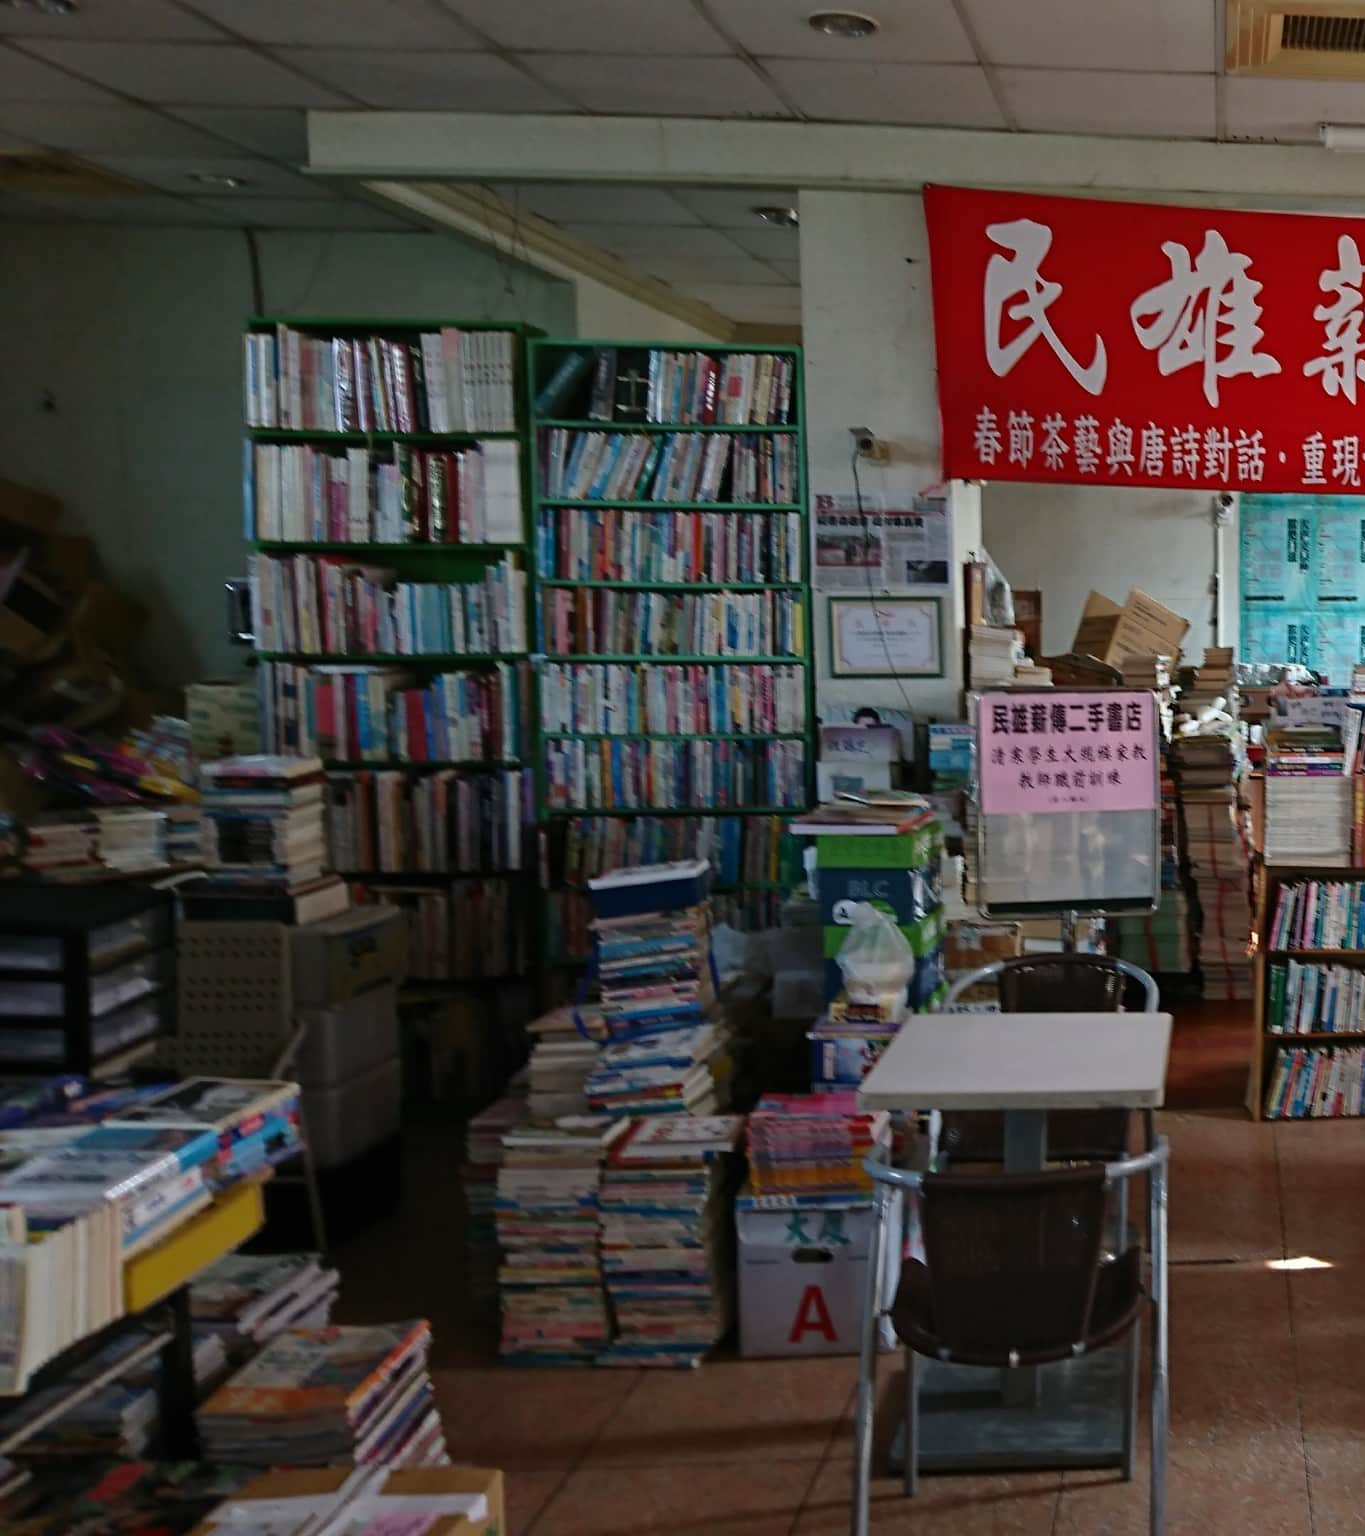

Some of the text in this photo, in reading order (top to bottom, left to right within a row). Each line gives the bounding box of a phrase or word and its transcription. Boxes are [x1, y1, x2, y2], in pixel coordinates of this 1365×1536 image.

[992, 702, 1142, 734] 民雄薪傳二手書店
[788, 1284, 837, 1343] A
